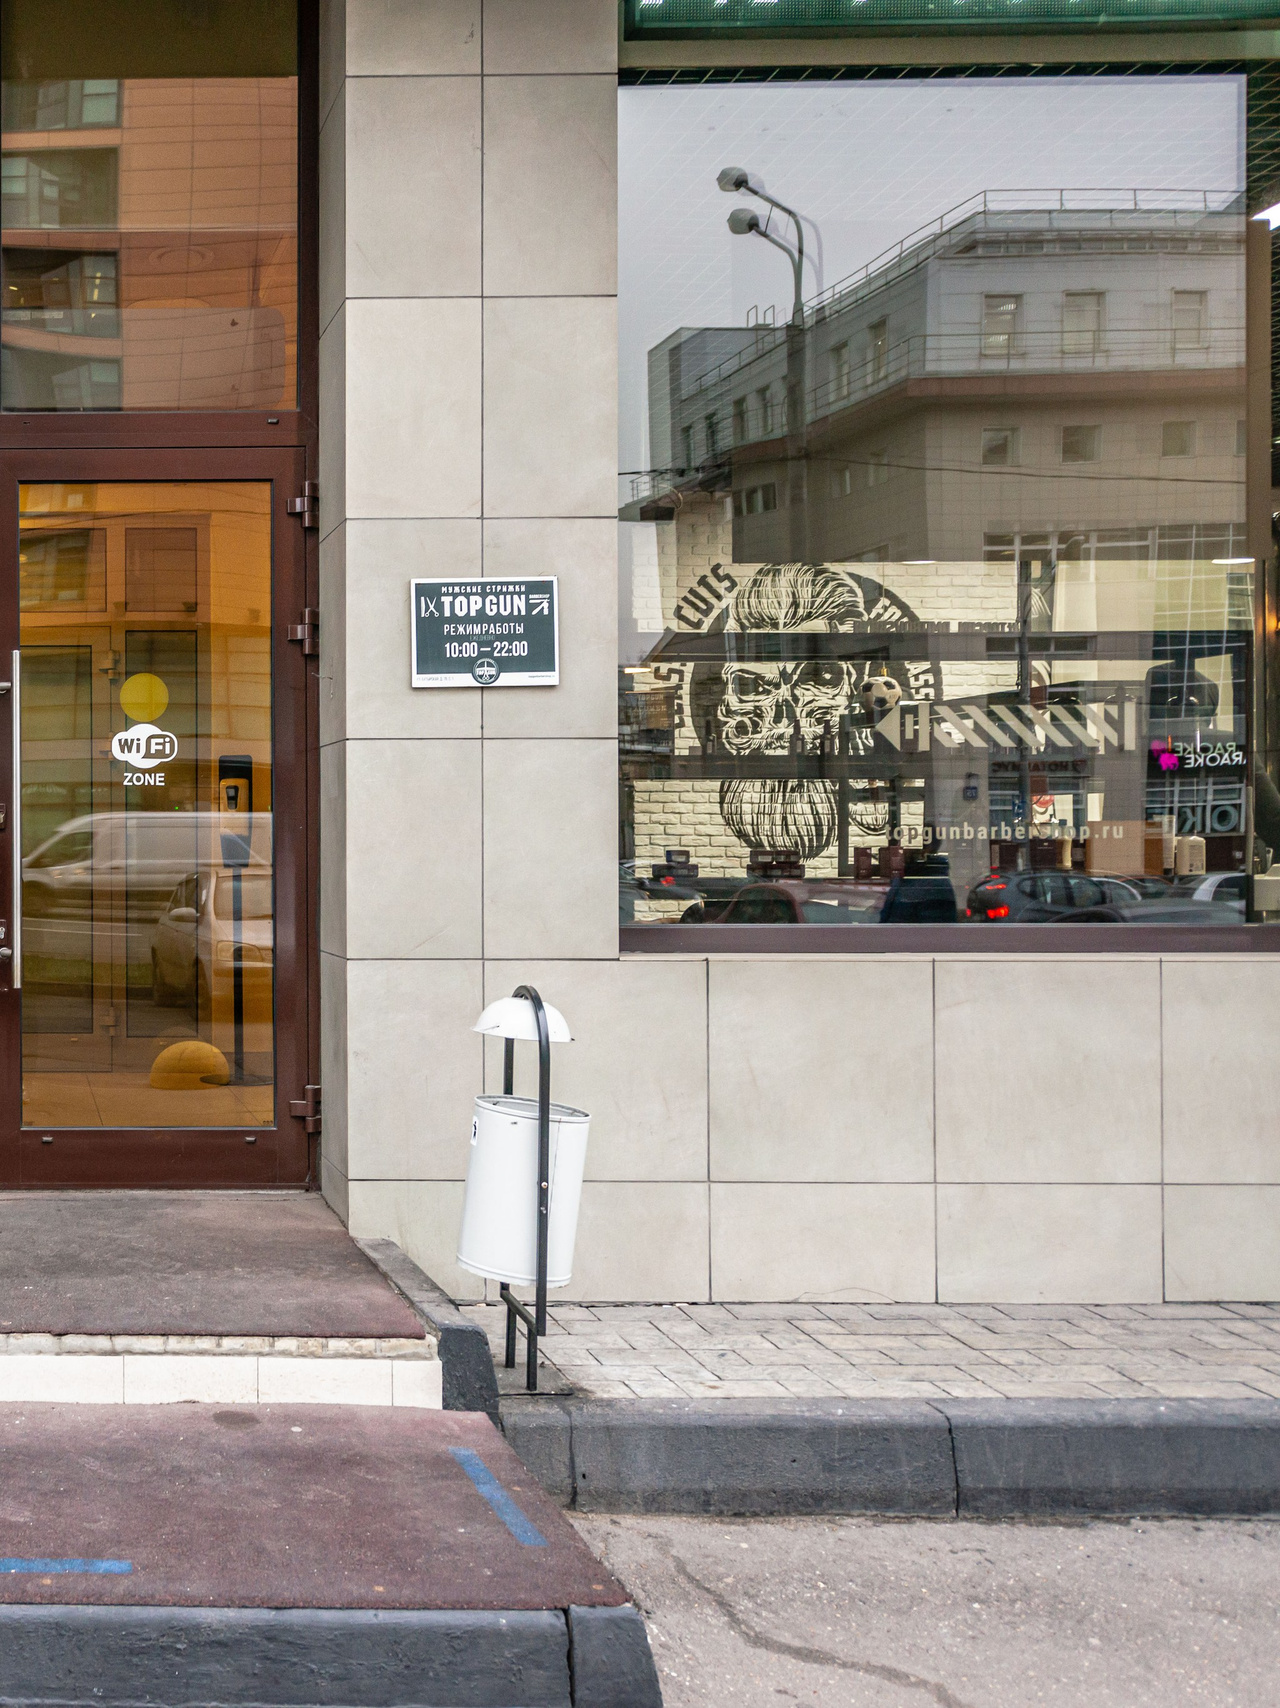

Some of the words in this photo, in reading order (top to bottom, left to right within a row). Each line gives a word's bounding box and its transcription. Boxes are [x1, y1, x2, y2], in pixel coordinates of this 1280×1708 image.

[441, 585, 482, 594] МУЖСКИЕ
[486, 584, 526, 593] СТРИЖКИ
[673, 562, 738, 630] CUTS
[440, 595, 483, 618] TOP
[485, 594, 526, 617] GUN
[443, 624, 481, 636] РЕЖИМ
[482, 622, 524, 635] РАБОТЫ
[444, 642, 478, 658] 10:00
[493, 640, 529, 657] 22:00
[123, 773, 165, 786] ZONE
[885, 821, 1124, 844] topgunbarbershop.ru
